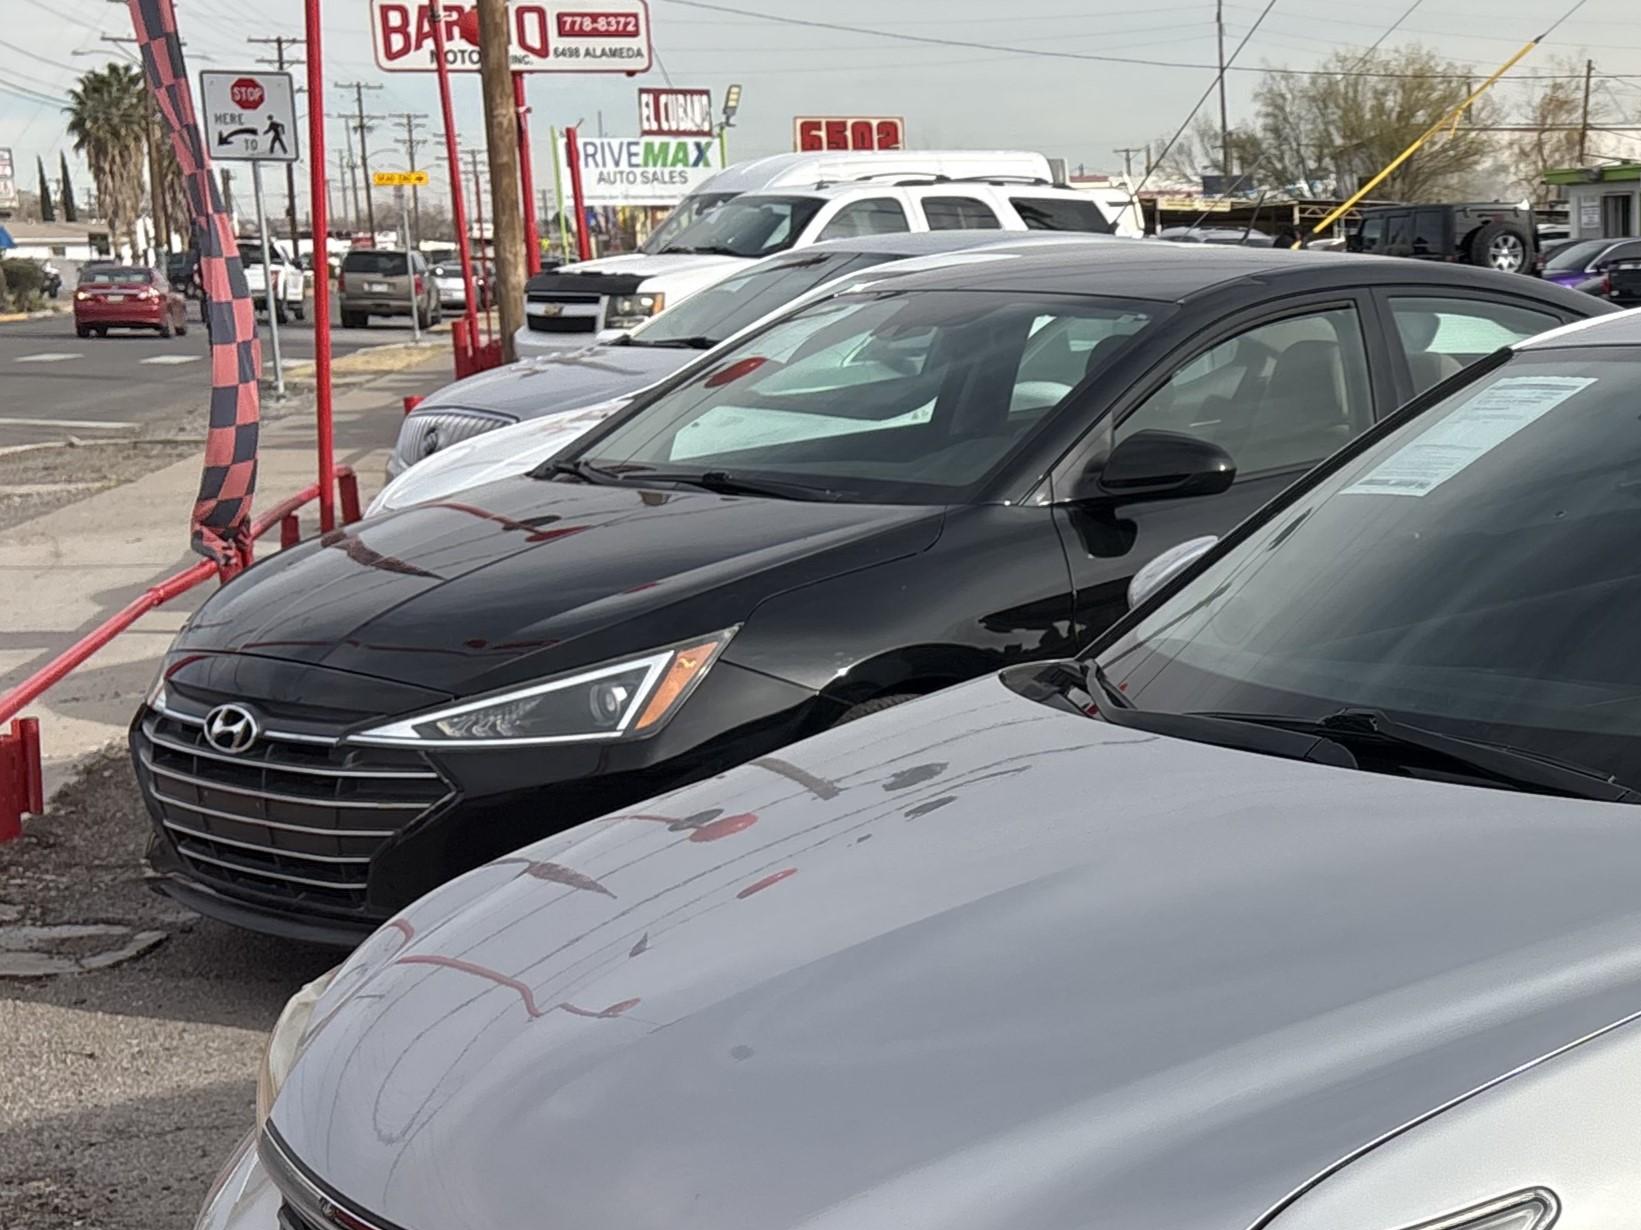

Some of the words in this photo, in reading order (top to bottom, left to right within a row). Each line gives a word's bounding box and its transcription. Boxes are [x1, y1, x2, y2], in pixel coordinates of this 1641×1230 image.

[562, 16, 637, 32] 778-8372
[583, 46, 644, 58] ALAMEDA
[232, 86, 263, 102] STOP
[214, 112, 245, 126] HERE
[640, 93, 658, 132] EL
[800, 120, 900, 152] 6502
[245, 138, 258, 151] TO
[597, 171, 637, 185] AUTO
[640, 171, 688, 185] SALES
